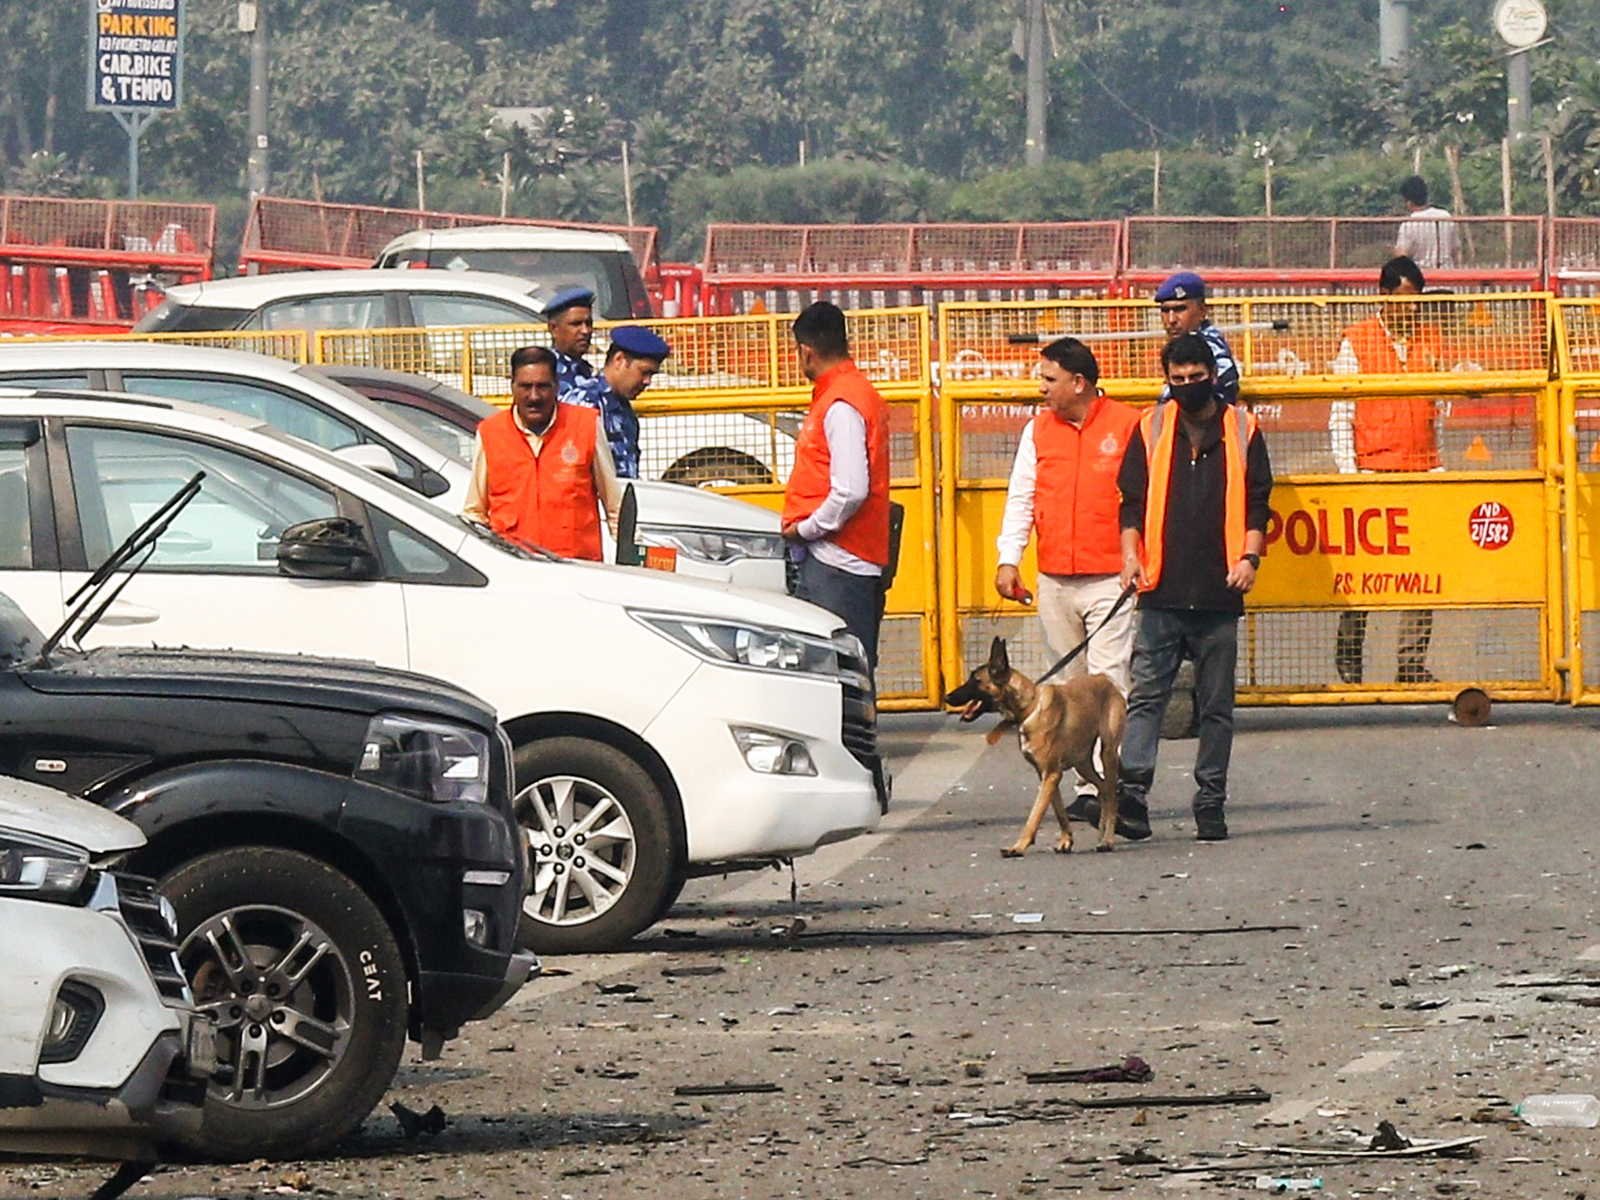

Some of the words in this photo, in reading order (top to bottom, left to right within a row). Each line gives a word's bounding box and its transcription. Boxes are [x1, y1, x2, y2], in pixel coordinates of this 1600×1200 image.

[99, 13, 176, 37] PARKING
[101, 76, 117, 104] &
[117, 77, 173, 102] TEMPO
[1479, 502, 1500, 518] ND
[1260, 507, 1411, 557] POLICE
[1362, 572, 1442, 595] KOTWALI
